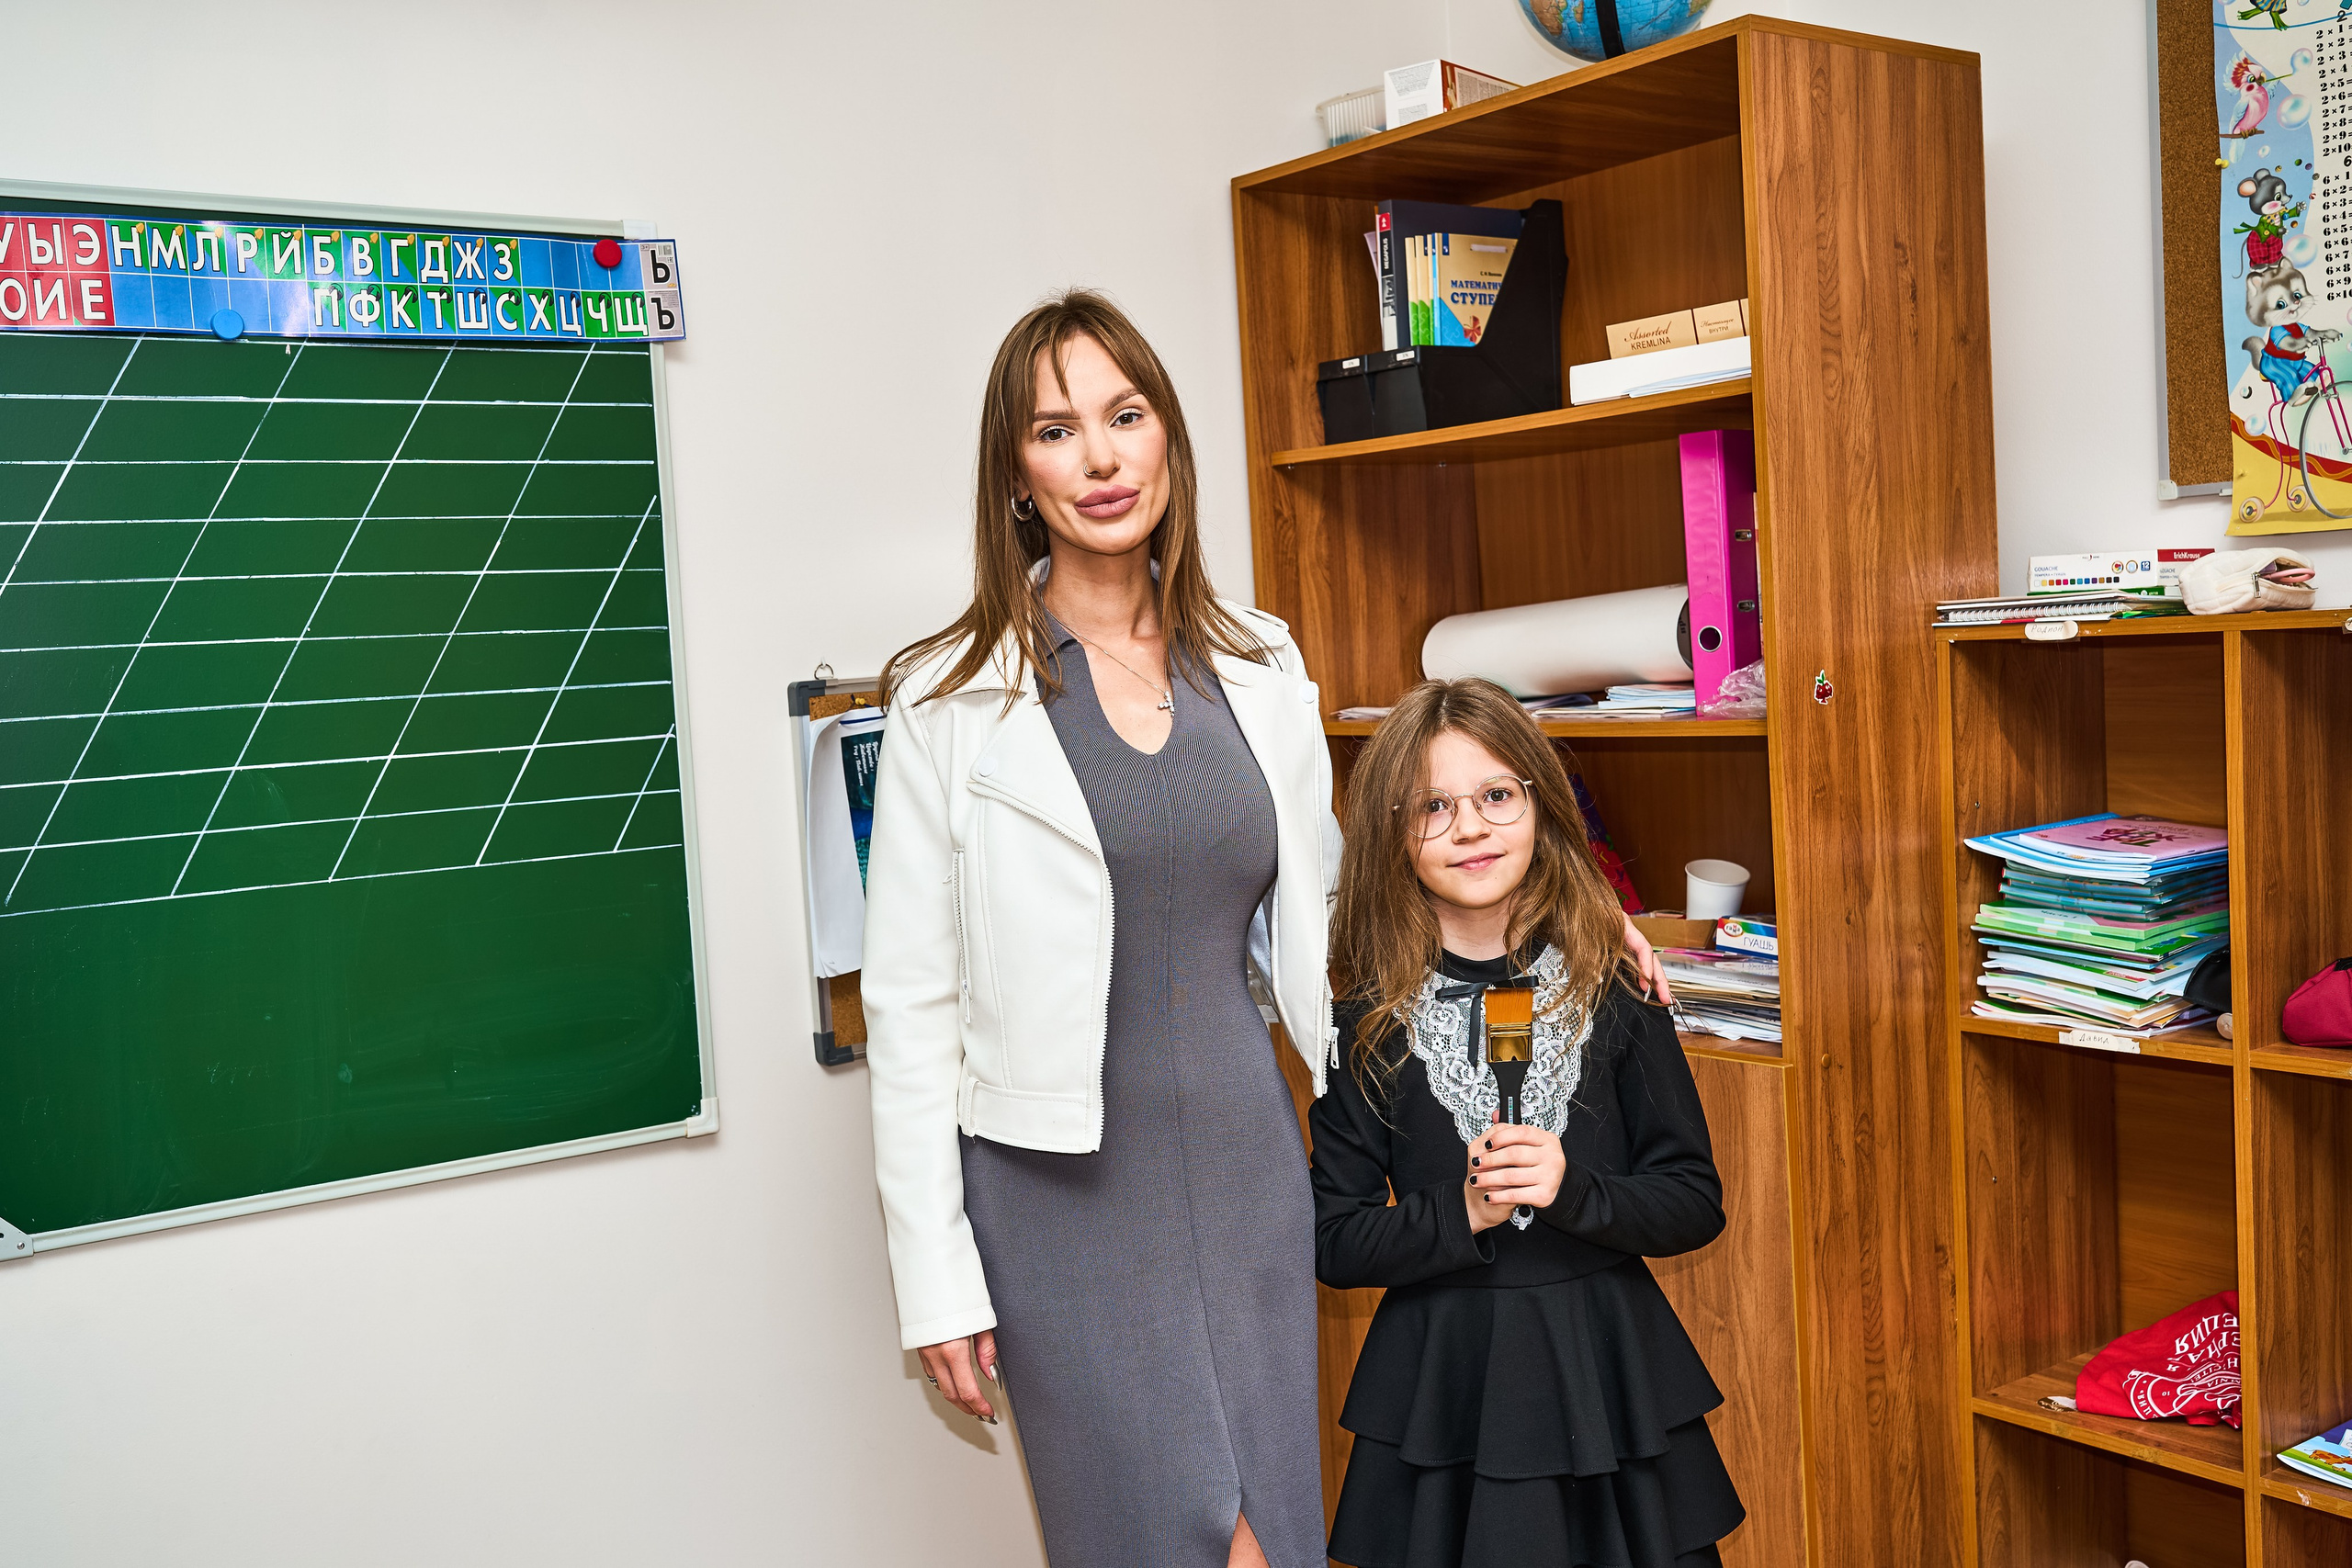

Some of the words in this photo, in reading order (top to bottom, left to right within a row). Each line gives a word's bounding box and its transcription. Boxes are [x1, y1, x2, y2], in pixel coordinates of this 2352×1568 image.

[27, 222, 64, 265] Ы
[72, 224, 101, 265] Э
[111, 225, 143, 267] Н
[151, 228, 187, 270] М
[191, 231, 221, 272] Л
[236, 232, 258, 273] Р
[312, 235, 336, 276] Б
[352, 237, 374, 276] В
[390, 238, 410, 276] Г
[421, 240, 449, 284] Д
[453, 241, 487, 280] Ж
[493, 243, 514, 281] З
[650, 249, 671, 283] Ь
[1450, 292, 1497, 305] СТУПЕ
[0, 279, 28, 321] О
[33, 279, 67, 320] И
[80, 279, 107, 320] Е
[313, 288, 340, 327] П
[349, 289, 380, 327] Ф
[390, 290, 416, 329] К
[426, 290, 447, 329] Т
[457, 292, 488, 330] Ш
[495, 291, 518, 331] С
[529, 293, 554, 332] Х
[559, 295, 582, 337] Ц
[588, 295, 608, 333] Ч
[616, 296, 649, 337] Щ
[650, 297, 675, 331] Ъ
[1623, 321, 1672, 343] Assorted
[1709, 325, 1729, 334] ВНУТРИ
[1630, 336, 1672, 351] KREMLINA
[1743, 936, 1774, 951] ГУАШЬ
